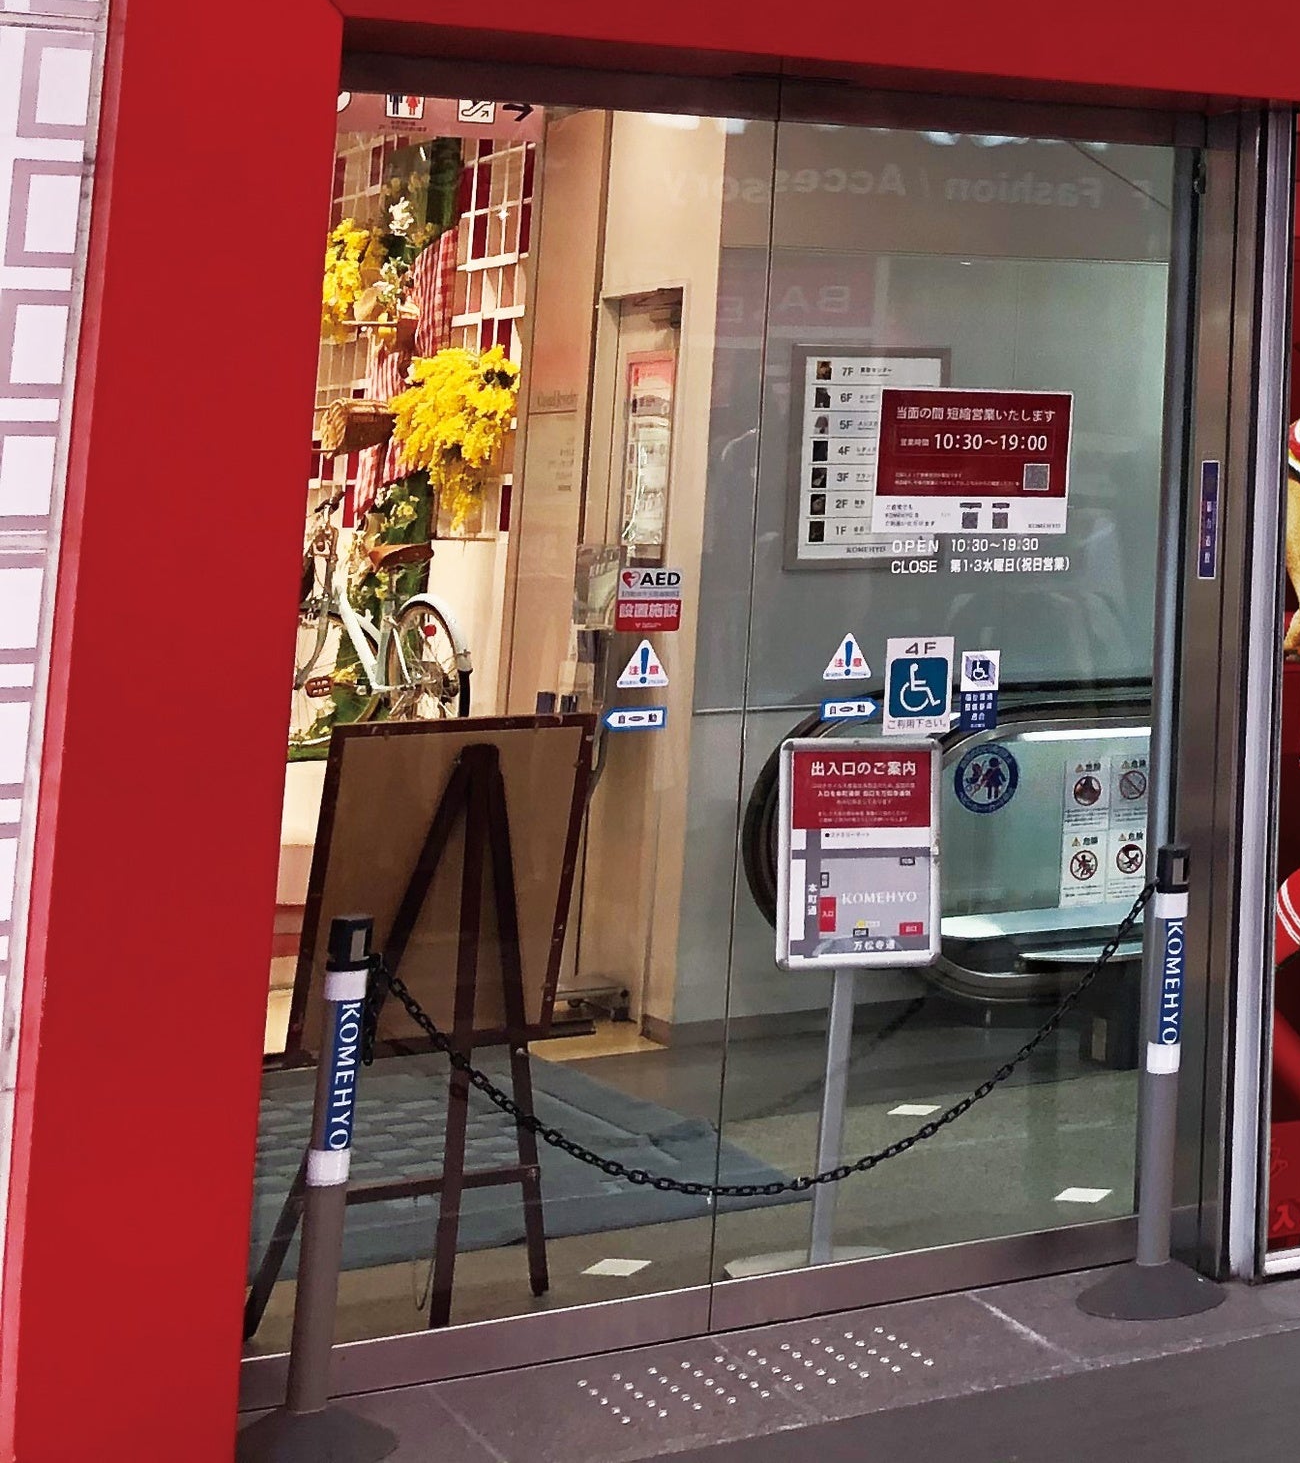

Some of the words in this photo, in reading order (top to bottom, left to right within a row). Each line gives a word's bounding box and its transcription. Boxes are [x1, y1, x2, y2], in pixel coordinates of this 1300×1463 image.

[842, 367, 854, 376] 7F
[840, 393, 853, 402] 6F
[897, 407, 944, 420] 当面の間
[947, 408, 1056, 422] 短縮営業いたします
[838, 446, 850, 455] 4F
[836, 473, 849, 482] 3F
[835, 499, 848, 509] 2F
[835, 526, 847, 535] 1F
[892, 539, 939, 554] OPEN
[891, 560, 938, 574] CLOSE
[640, 572, 681, 586] AED
[905, 642, 937, 657] 4F
[811, 761, 917, 776] 出入口のご案内
[841, 891, 919, 905] KOMEHYO
[1161, 919, 1185, 1045] KOMEHYO
[329, 1001, 361, 1150] KOMEHYO
